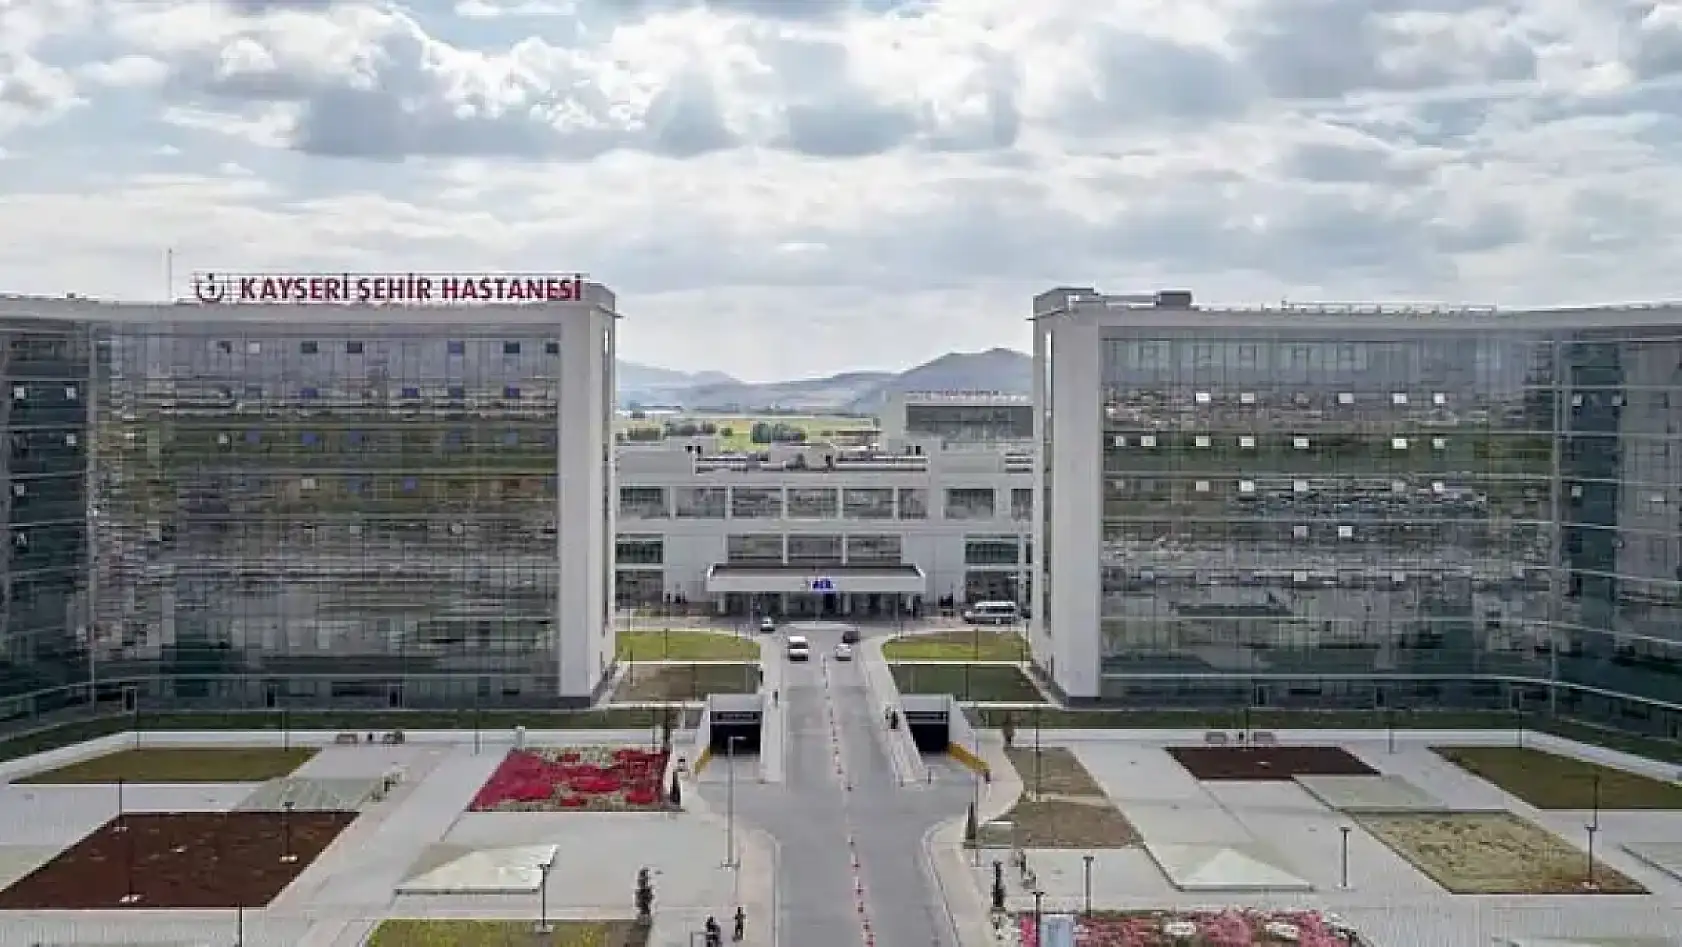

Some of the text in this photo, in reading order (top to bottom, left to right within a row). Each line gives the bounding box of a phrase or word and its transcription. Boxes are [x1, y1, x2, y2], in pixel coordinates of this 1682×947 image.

[240, 272, 582, 302] KAYSERİ ŞEHİR HASTANESİ
